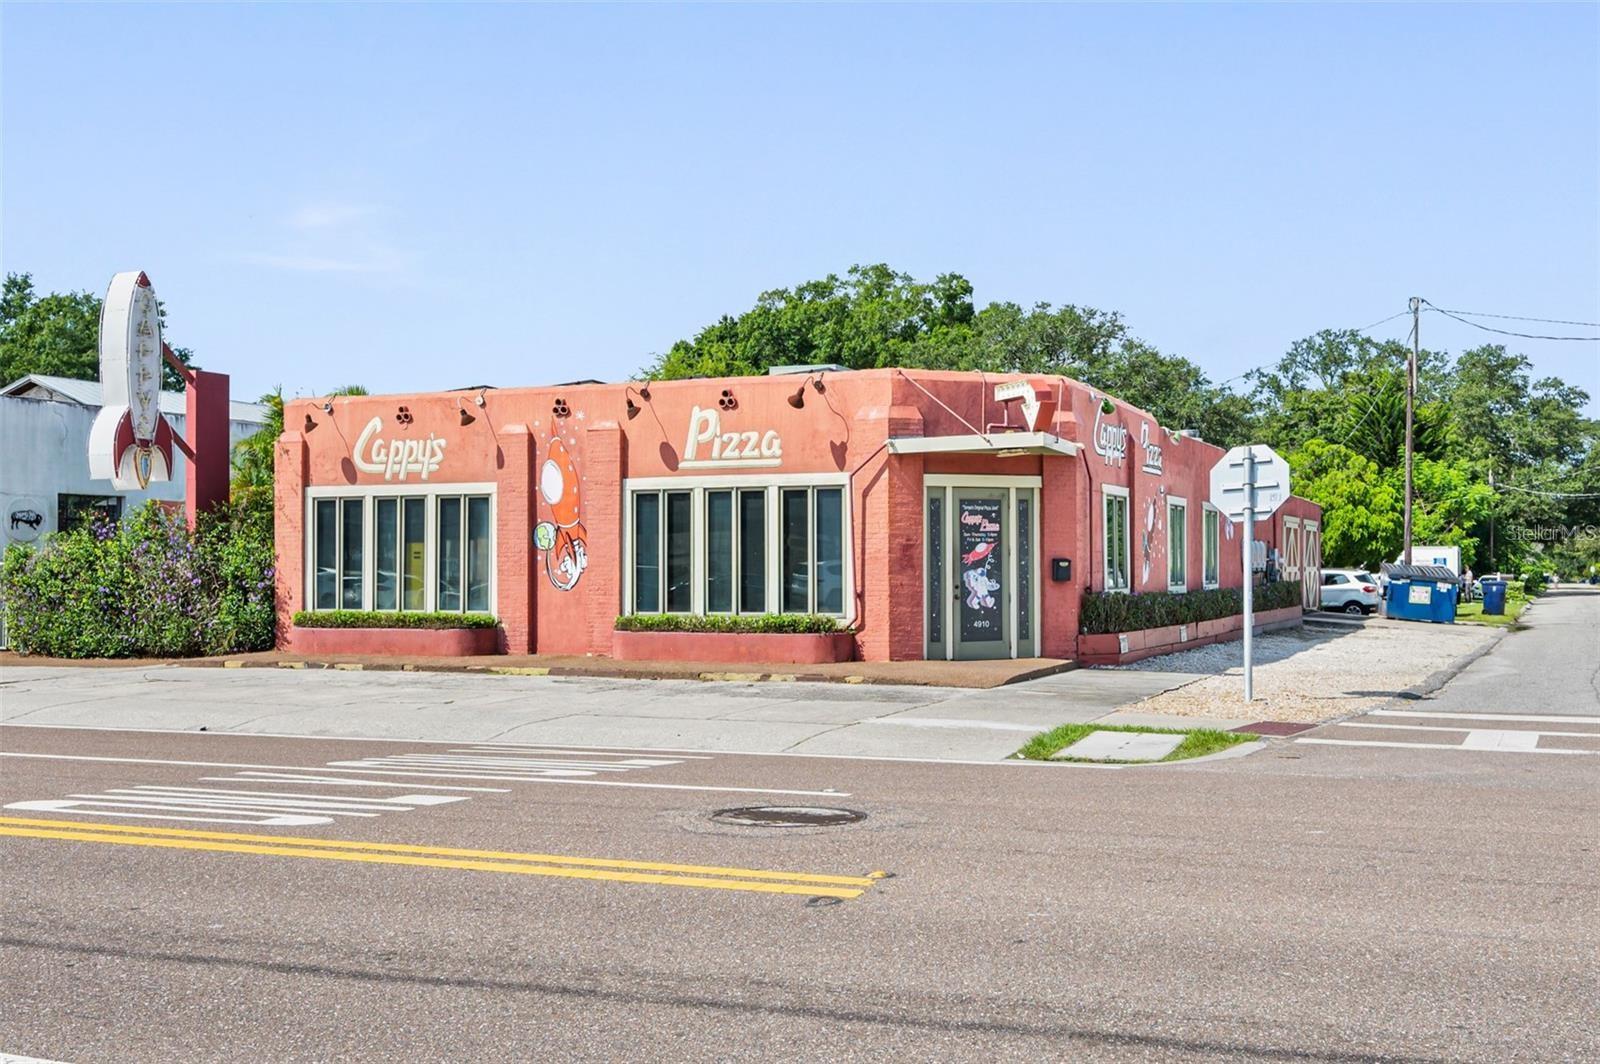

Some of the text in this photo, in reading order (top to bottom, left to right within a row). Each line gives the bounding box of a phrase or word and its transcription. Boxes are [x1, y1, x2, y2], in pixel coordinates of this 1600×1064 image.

[353, 405, 783, 480] Cappy's Pizza
[1094, 399, 1162, 469] Cappy's Pizza
[973, 620, 990, 628] 4910
[327, 746, 713, 776] ONLY
[4, 771, 511, 826] ONLY
